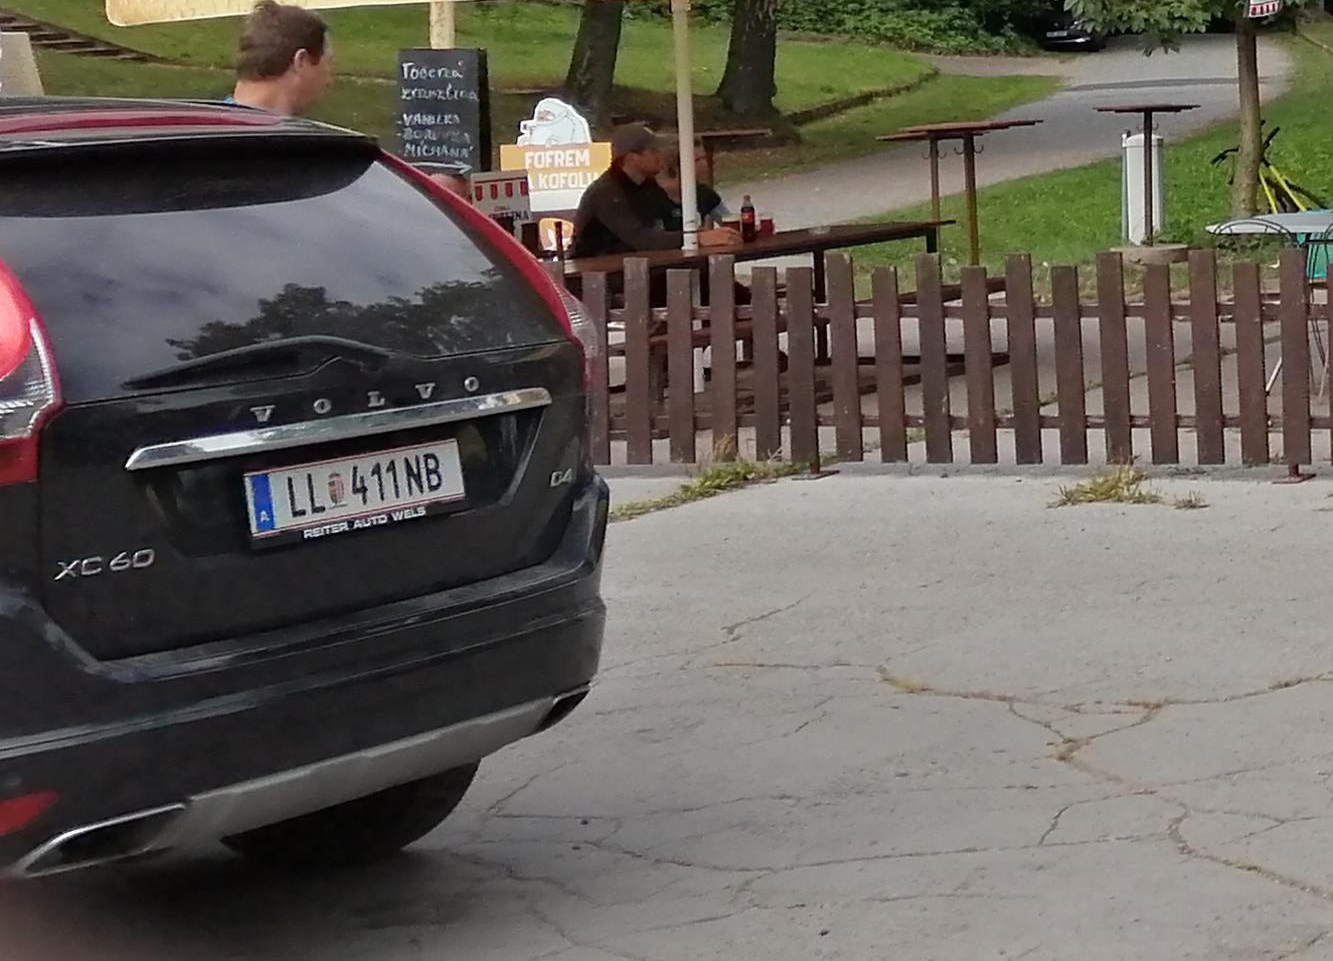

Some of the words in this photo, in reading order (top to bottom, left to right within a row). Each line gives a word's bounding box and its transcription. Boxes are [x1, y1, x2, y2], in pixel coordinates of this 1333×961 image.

[524, 149, 590, 169] FOFREM
[250, 376, 480, 424] VOLVO
[286, 472, 327, 518] LL
[350, 452, 443, 506] 411NB
[303, 520, 350, 540] REITER
[353, 512, 388, 531] AUTO
[390, 505, 427, 523] WELS
